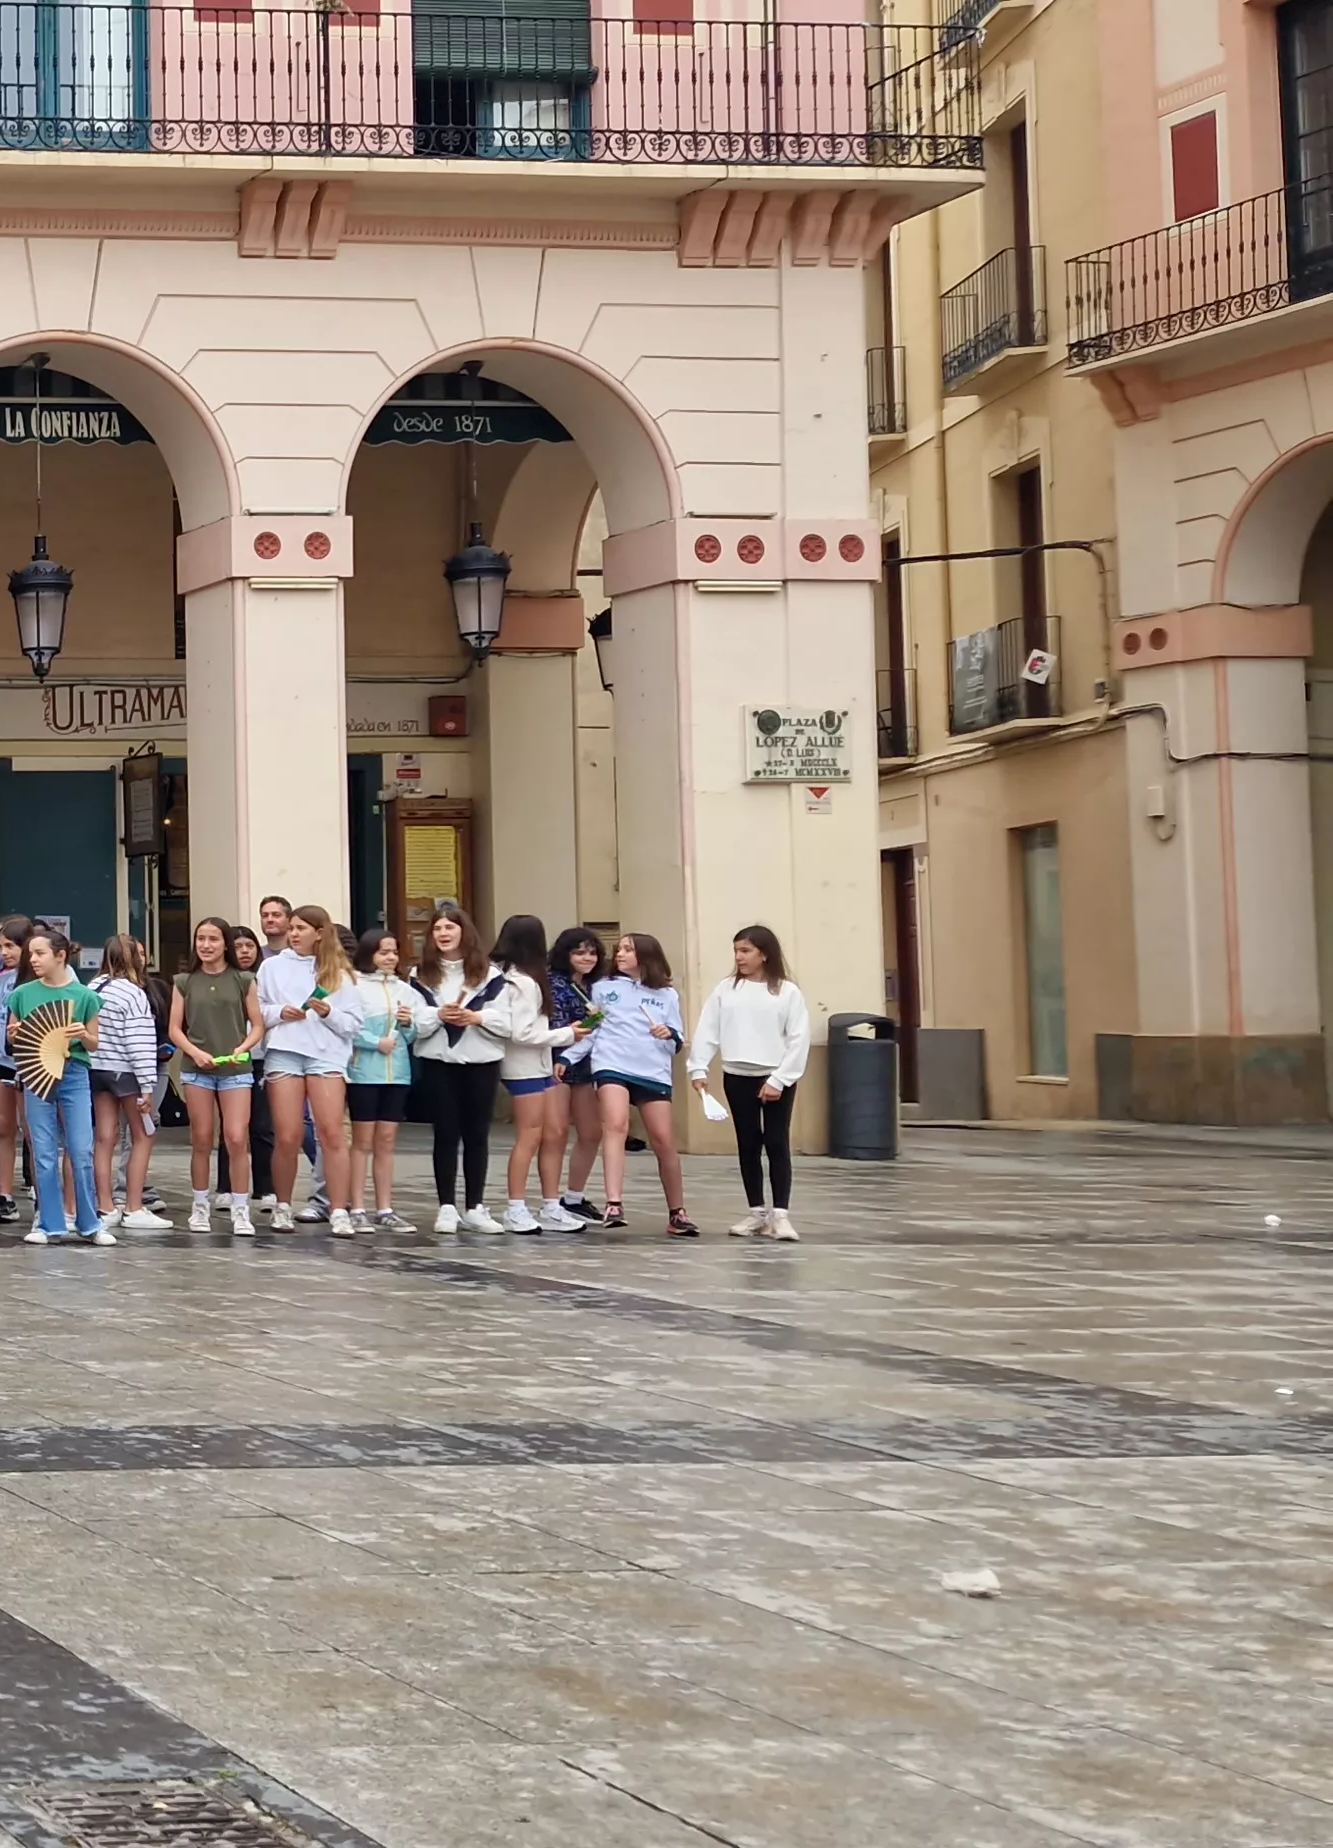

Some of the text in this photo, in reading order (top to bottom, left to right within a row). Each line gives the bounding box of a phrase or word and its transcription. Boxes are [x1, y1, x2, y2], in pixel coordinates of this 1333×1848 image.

[5, 407, 121, 438] LA CONFIANZA
[393, 412, 493, 436] desde 1871
[51, 684, 187, 731] ULTRAMA
[397, 719, 419, 733] 1871
[782, 718, 818, 728] PLAZA
